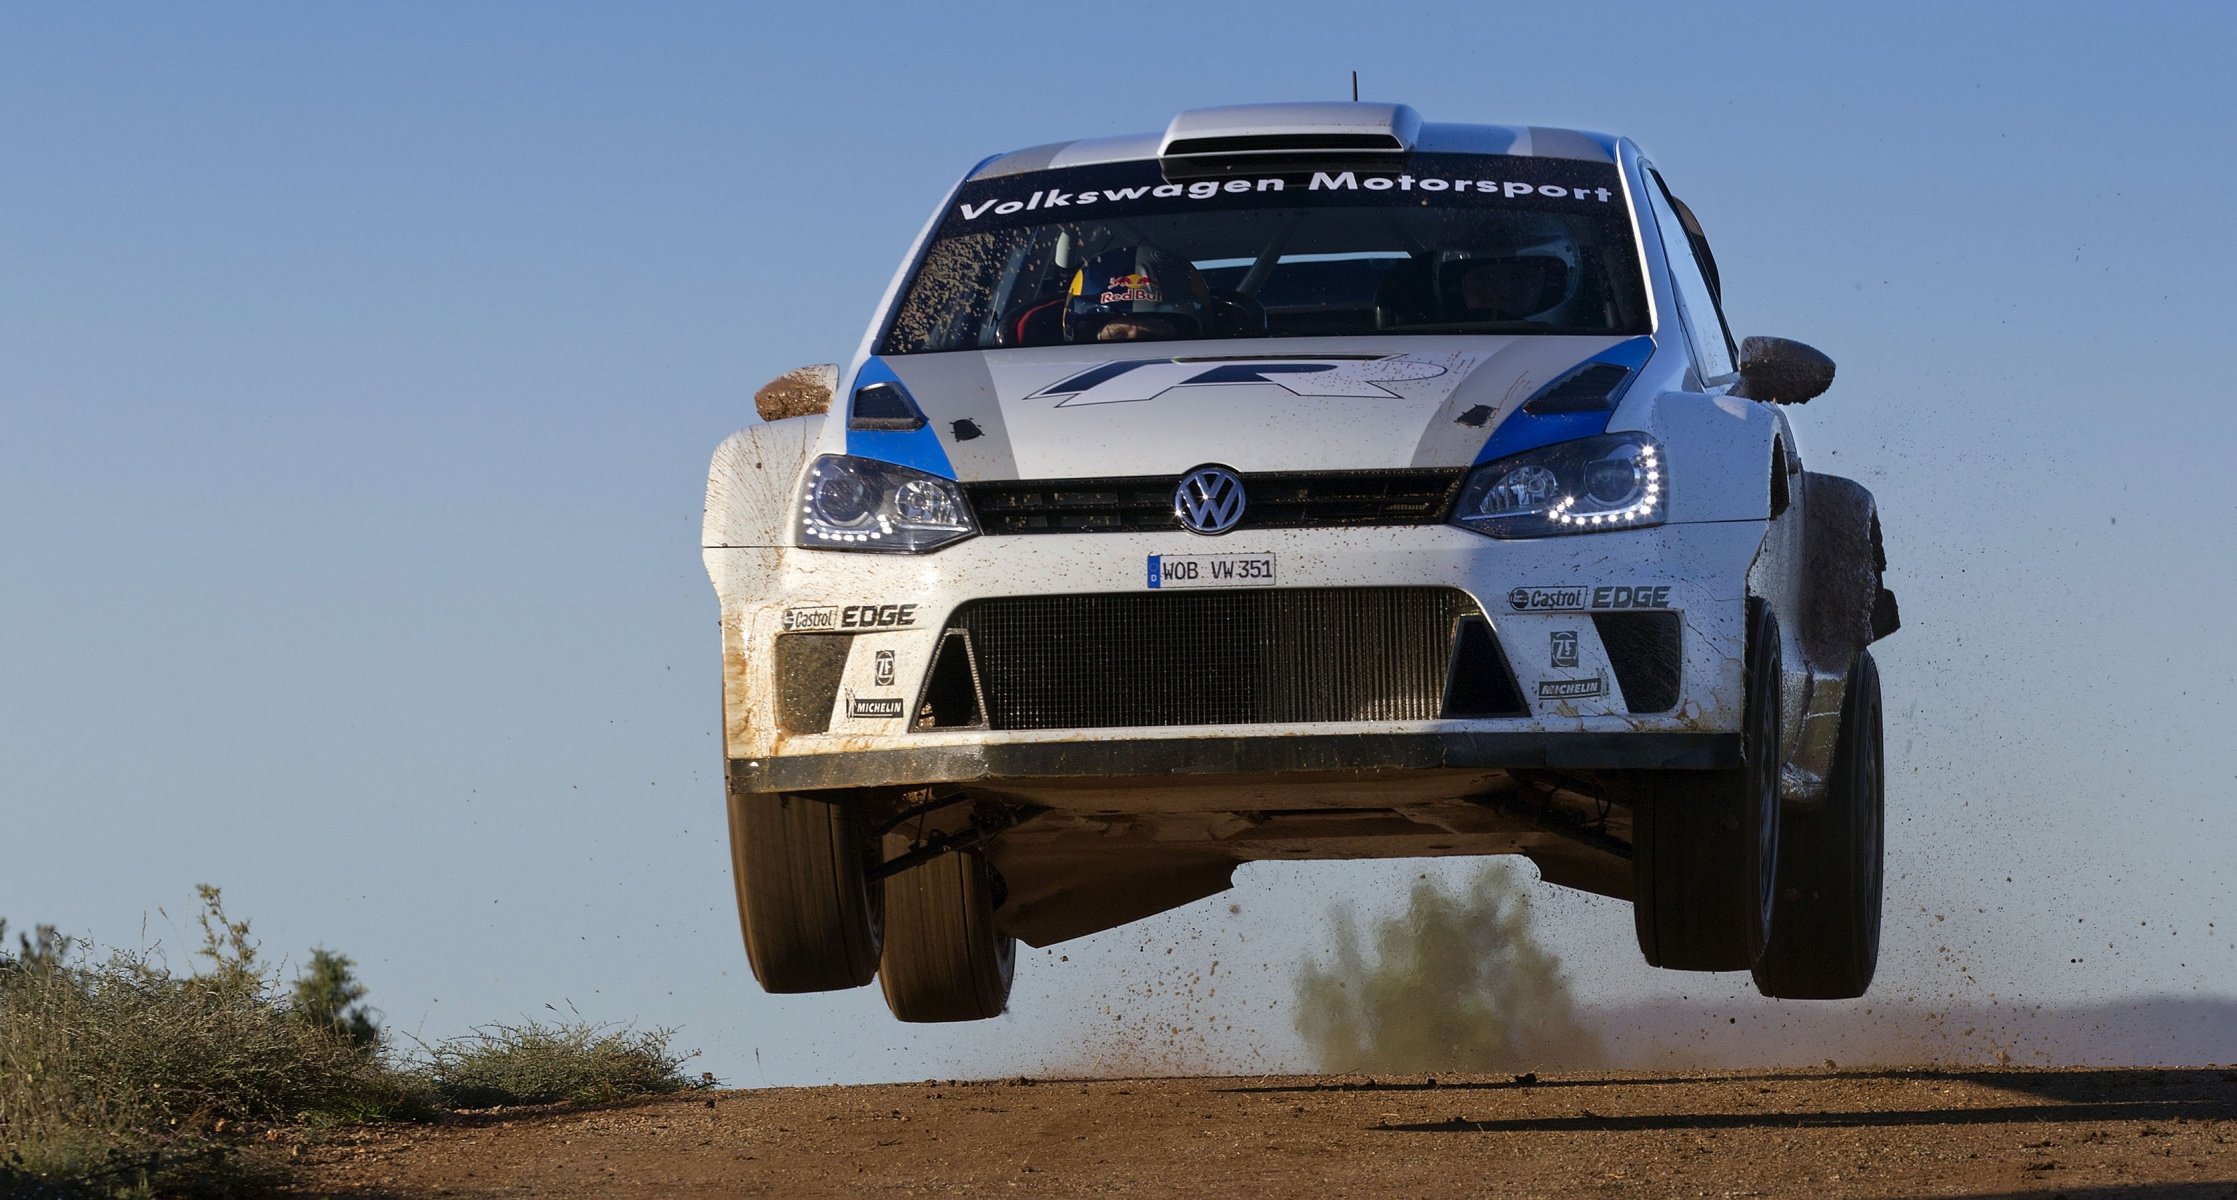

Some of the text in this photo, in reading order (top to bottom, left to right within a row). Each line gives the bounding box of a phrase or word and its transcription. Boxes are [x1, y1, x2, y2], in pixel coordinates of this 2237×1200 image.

[959, 171, 1612, 221] Volkswagen Motorsport
[1101, 288, 1162, 304] Red Bul
[1162, 561, 1199, 580] WOB
[1211, 560, 1234, 579] VW
[1238, 560, 1273, 578] 351
[1530, 586, 1672, 609] Castrol EDGE
[795, 603, 919, 628] Castrol EDGE
[1541, 681, 1599, 696] MICHELIN
[857, 702, 902, 713] MICHELIN
